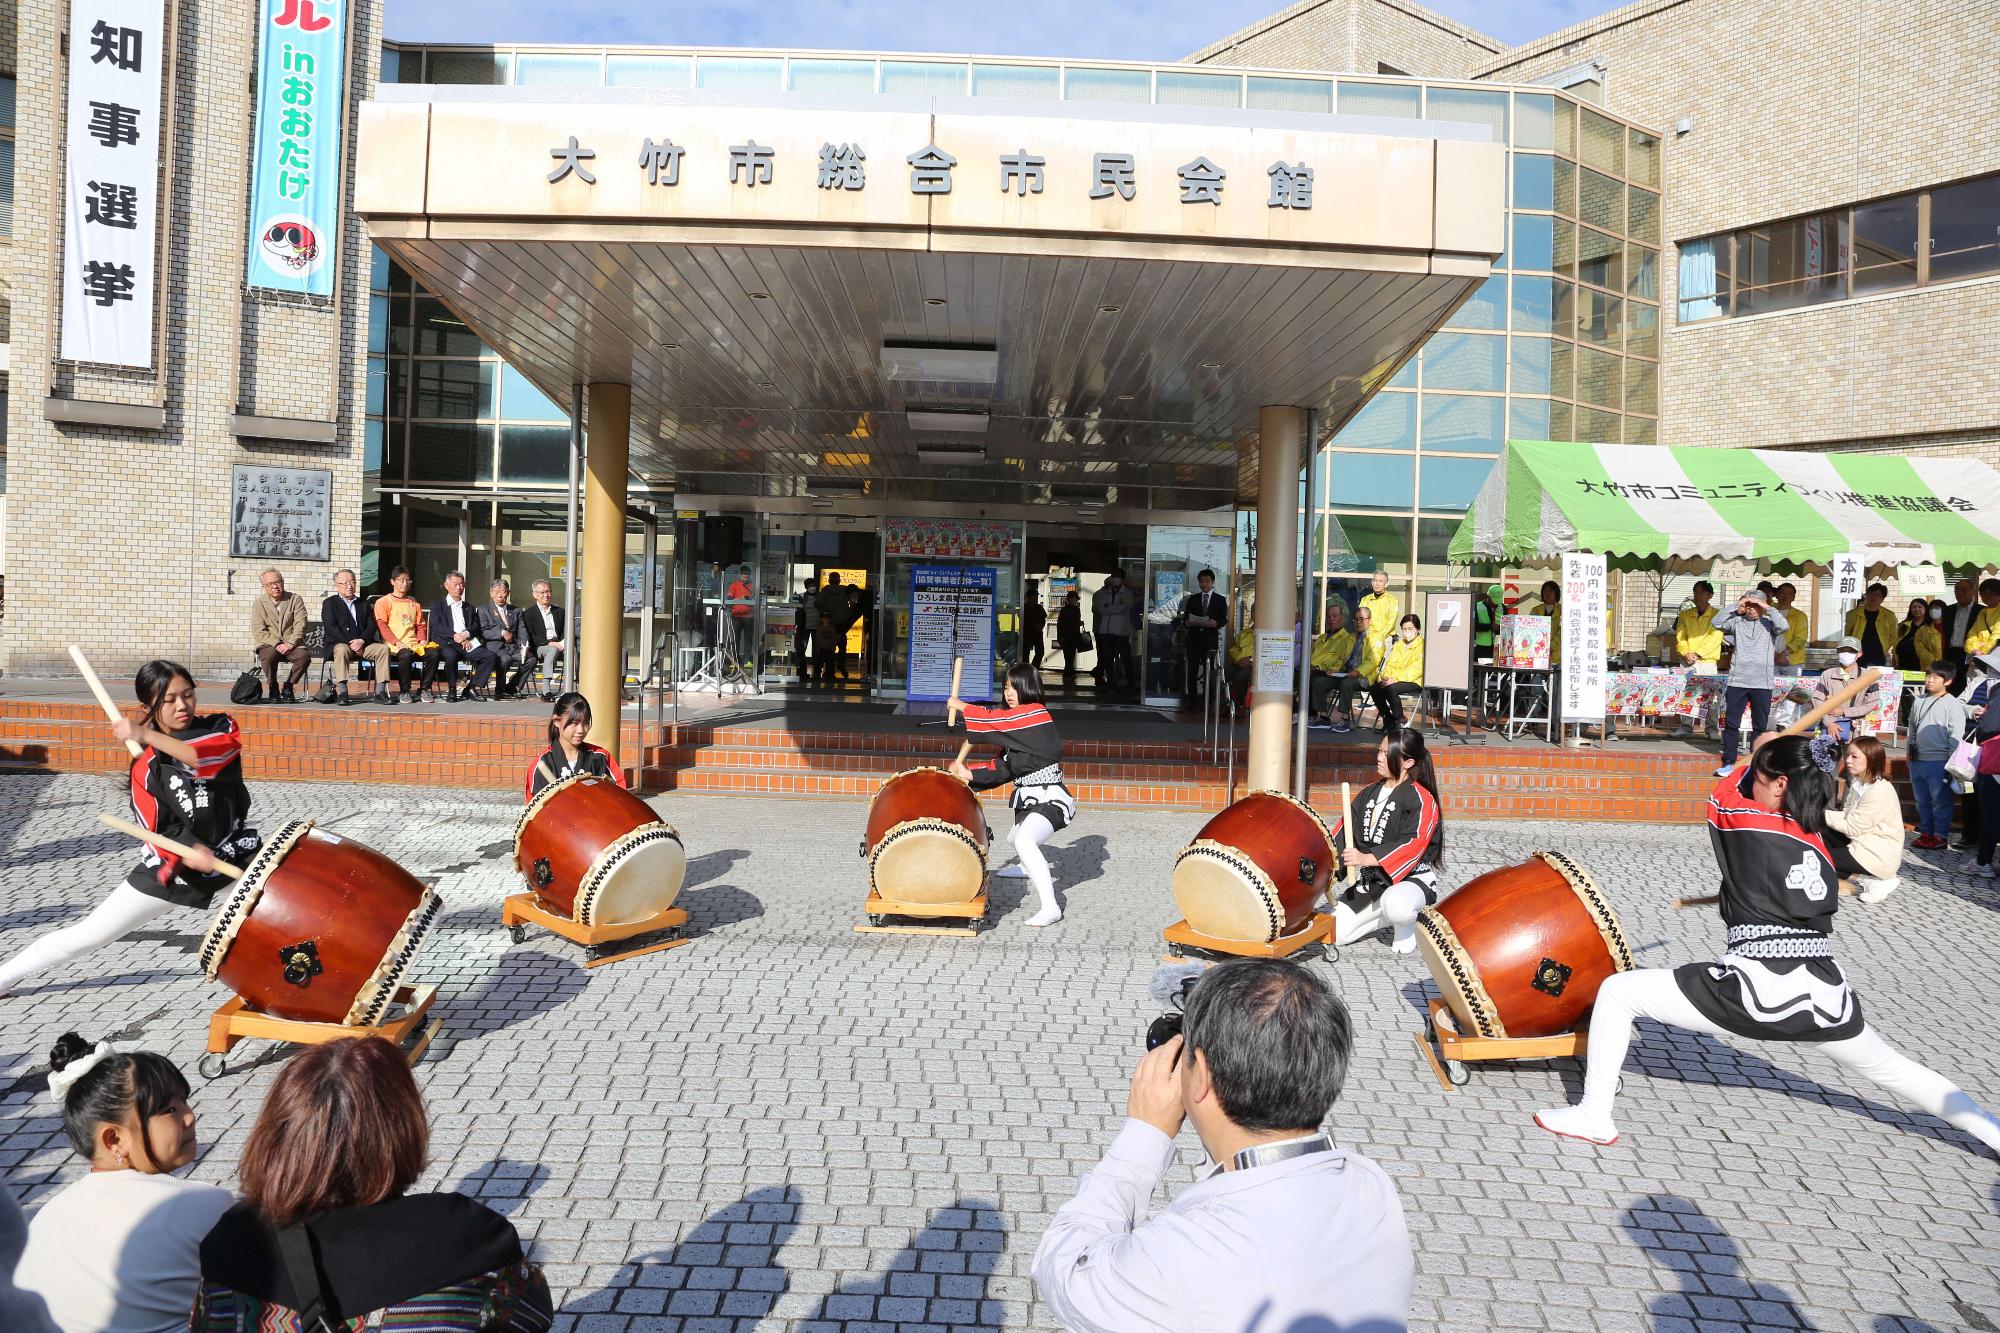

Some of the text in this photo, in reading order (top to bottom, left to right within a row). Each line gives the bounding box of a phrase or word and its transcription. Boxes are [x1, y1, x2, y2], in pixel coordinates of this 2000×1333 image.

[83, 19, 143, 307] 知事選挙
[547, 136, 1316, 209] 大竹市総合市民会館
[1839, 557, 1862, 595] 本部
